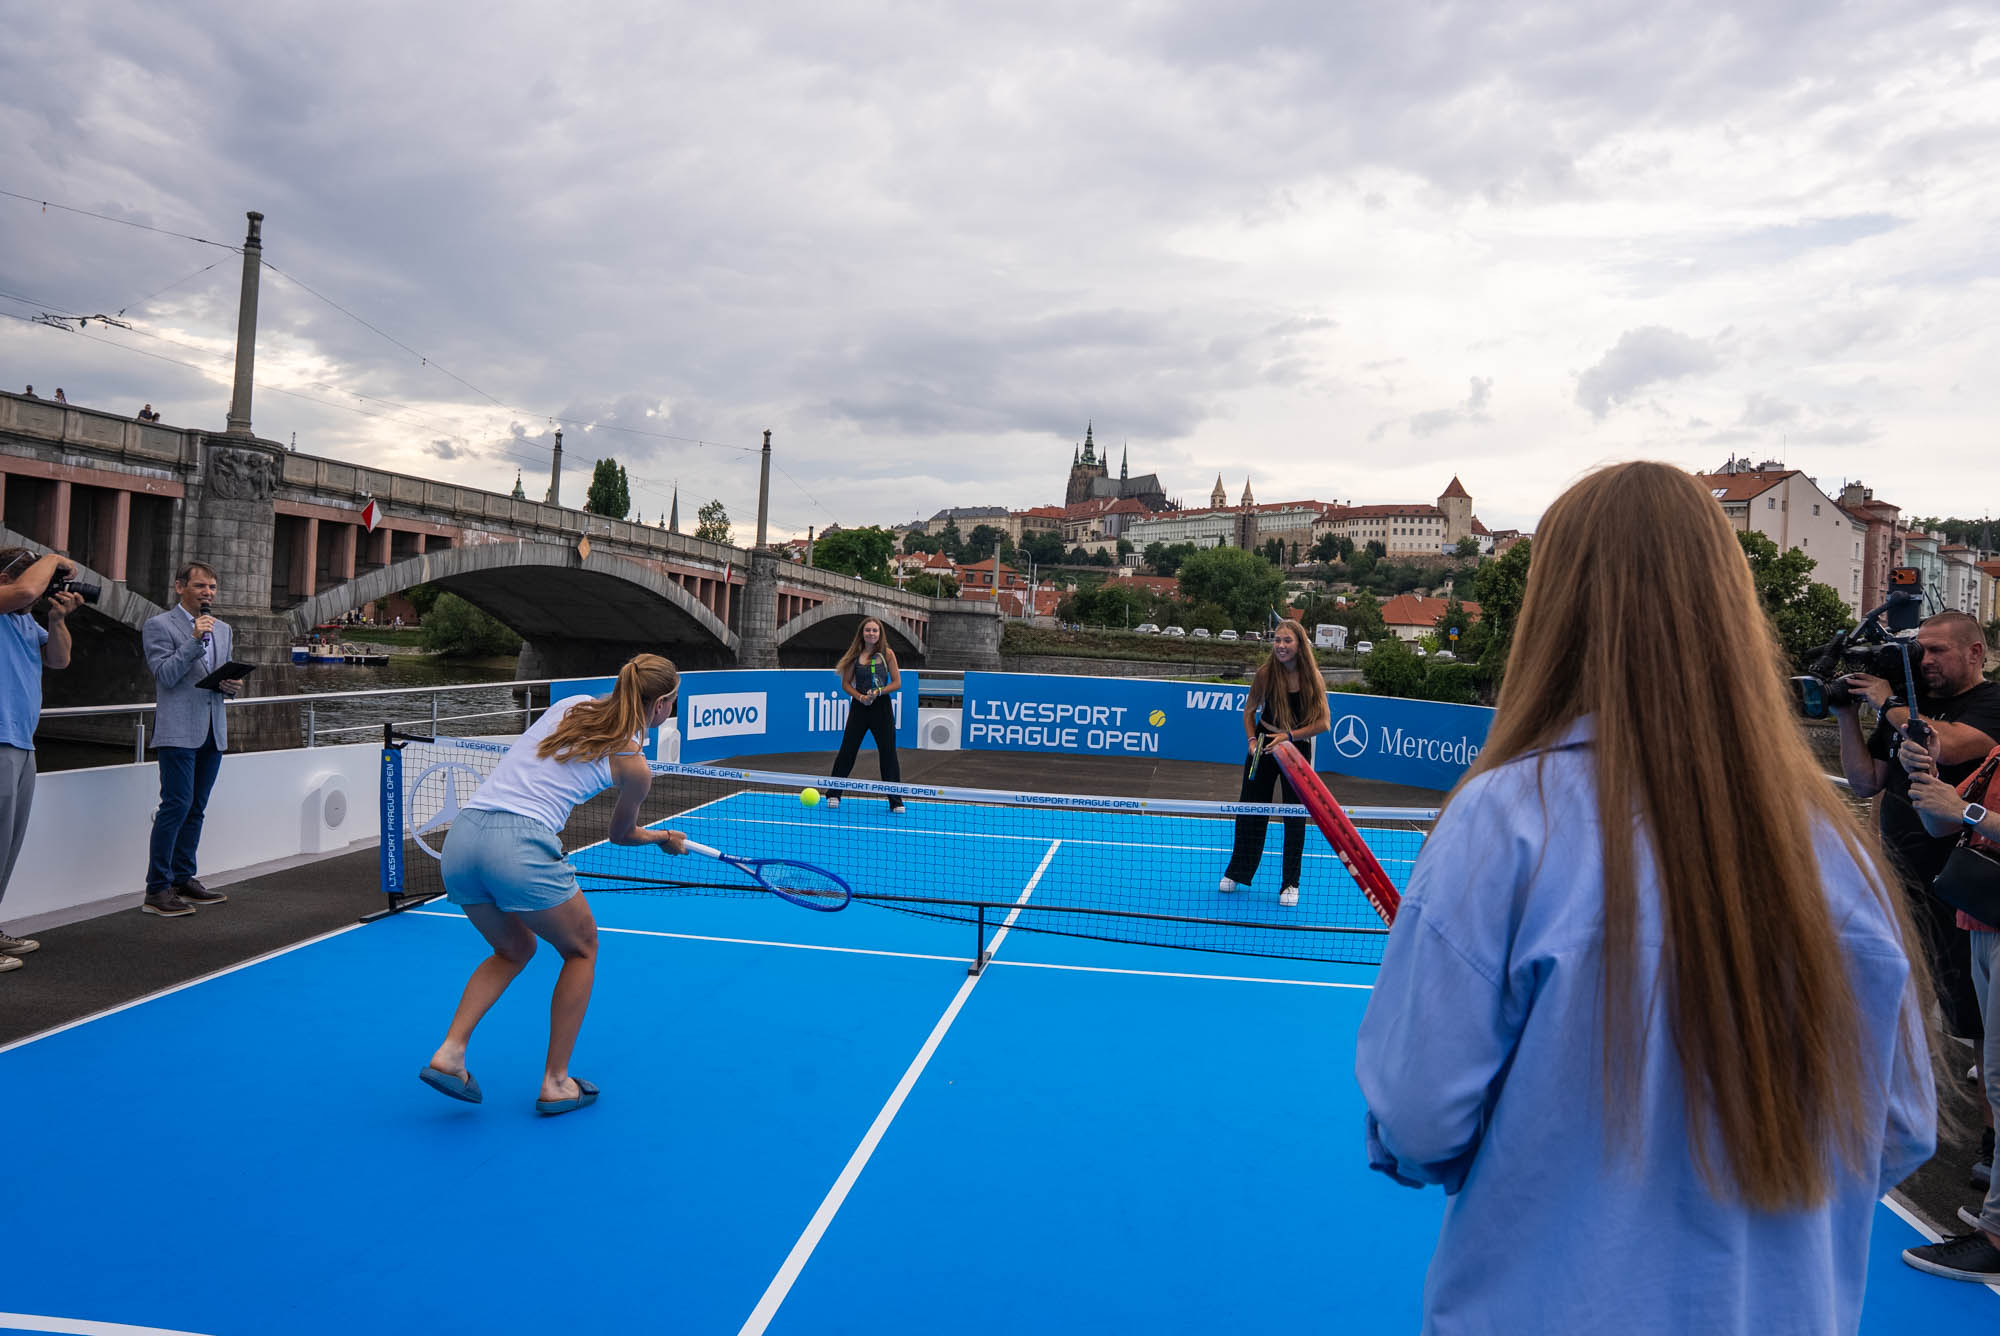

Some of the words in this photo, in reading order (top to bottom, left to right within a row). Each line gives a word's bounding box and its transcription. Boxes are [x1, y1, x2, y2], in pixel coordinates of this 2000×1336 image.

[1186, 690, 1233, 711] WTA
[693, 704, 758, 728] Lenovo
[971, 699, 1128, 727] LIVESPORT
[455, 740, 501, 753] LIVESPORT
[969, 723, 1079, 748] PRAGUE
[1087, 729, 1159, 753] OPEN
[1379, 726, 1488, 766] Mercede
[385, 763, 394, 789] OPEN
[648, 763, 679, 773] ESPORT
[681, 766, 718, 777] PRAGUE
[718, 770, 743, 779] OPEN
[817, 778, 870, 792] LIVESPORT
[872, 784, 910, 795] PRAGUE
[911, 787, 937, 797] OPEN
[386, 791, 395, 831] PRAGUE
[1015, 794, 1071, 805] LIVESPORT
[1071, 798, 1111, 807] PRAGUE
[1113, 801, 1139, 809] OPEN
[1220, 805, 1276, 814] LIVESPORT
[387, 832, 397, 887] LIVESPORT
